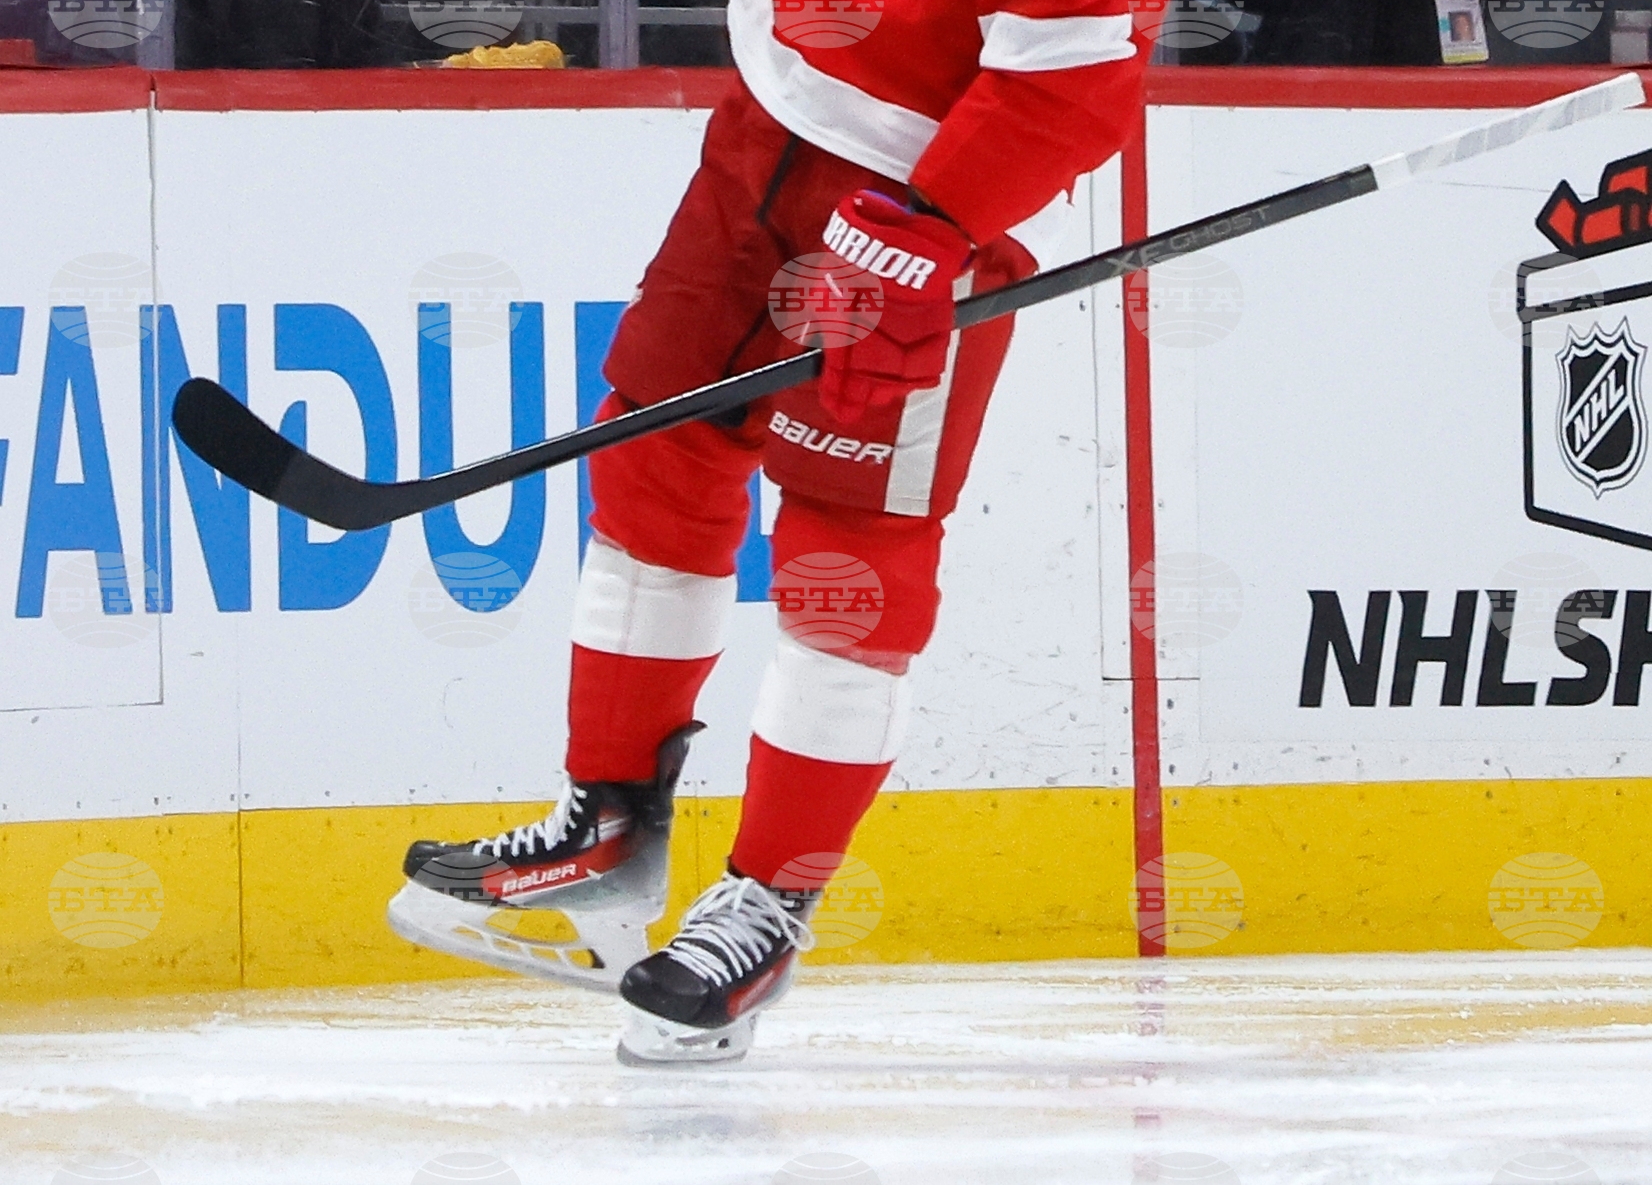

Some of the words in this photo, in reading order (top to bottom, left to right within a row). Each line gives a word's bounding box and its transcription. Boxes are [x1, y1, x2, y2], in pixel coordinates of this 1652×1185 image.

[822, 207, 938, 291] RRIOR
[1170, 204, 1271, 250] GHOST
[1573, 368, 1625, 453] NHL
